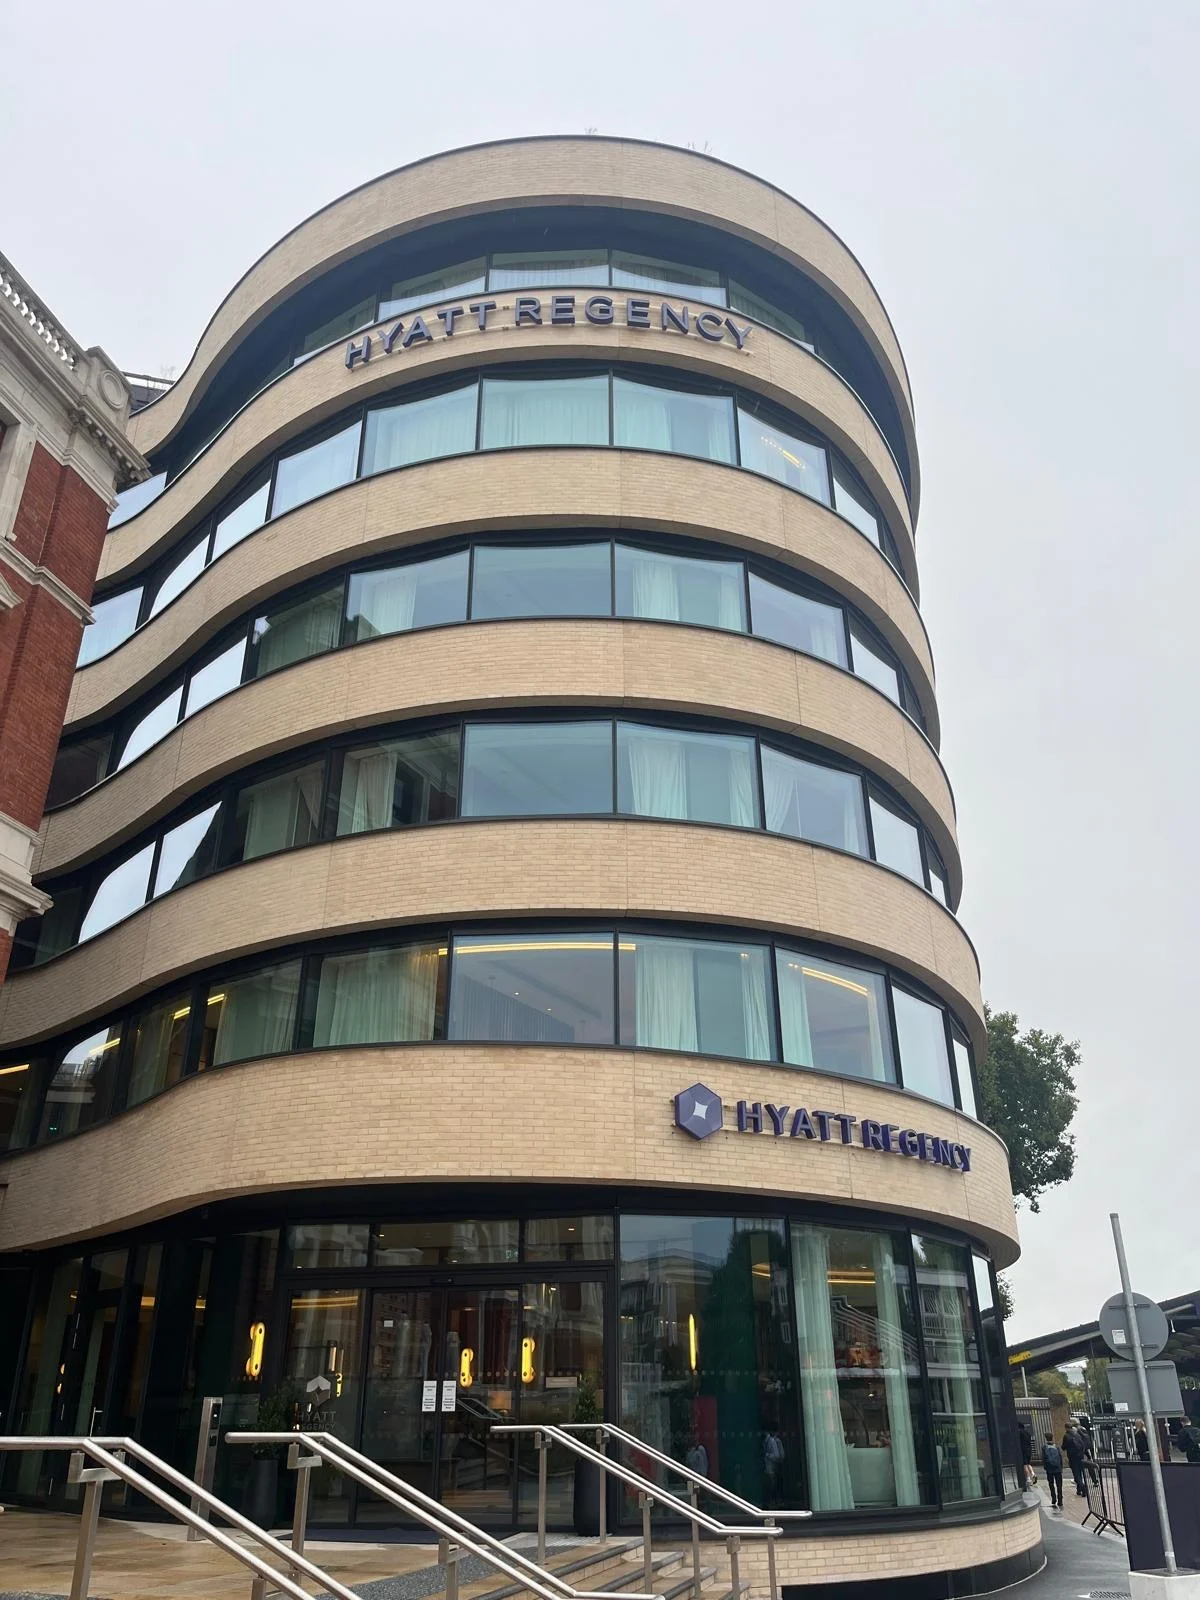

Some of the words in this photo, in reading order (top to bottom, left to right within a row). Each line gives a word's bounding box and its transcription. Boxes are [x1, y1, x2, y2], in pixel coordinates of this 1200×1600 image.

[345, 301, 497, 370] HYATT
[515, 295, 753, 350] REGENCY
[736, 1100, 857, 1144] HYATT
[861, 1119, 972, 1172] REGENCY
